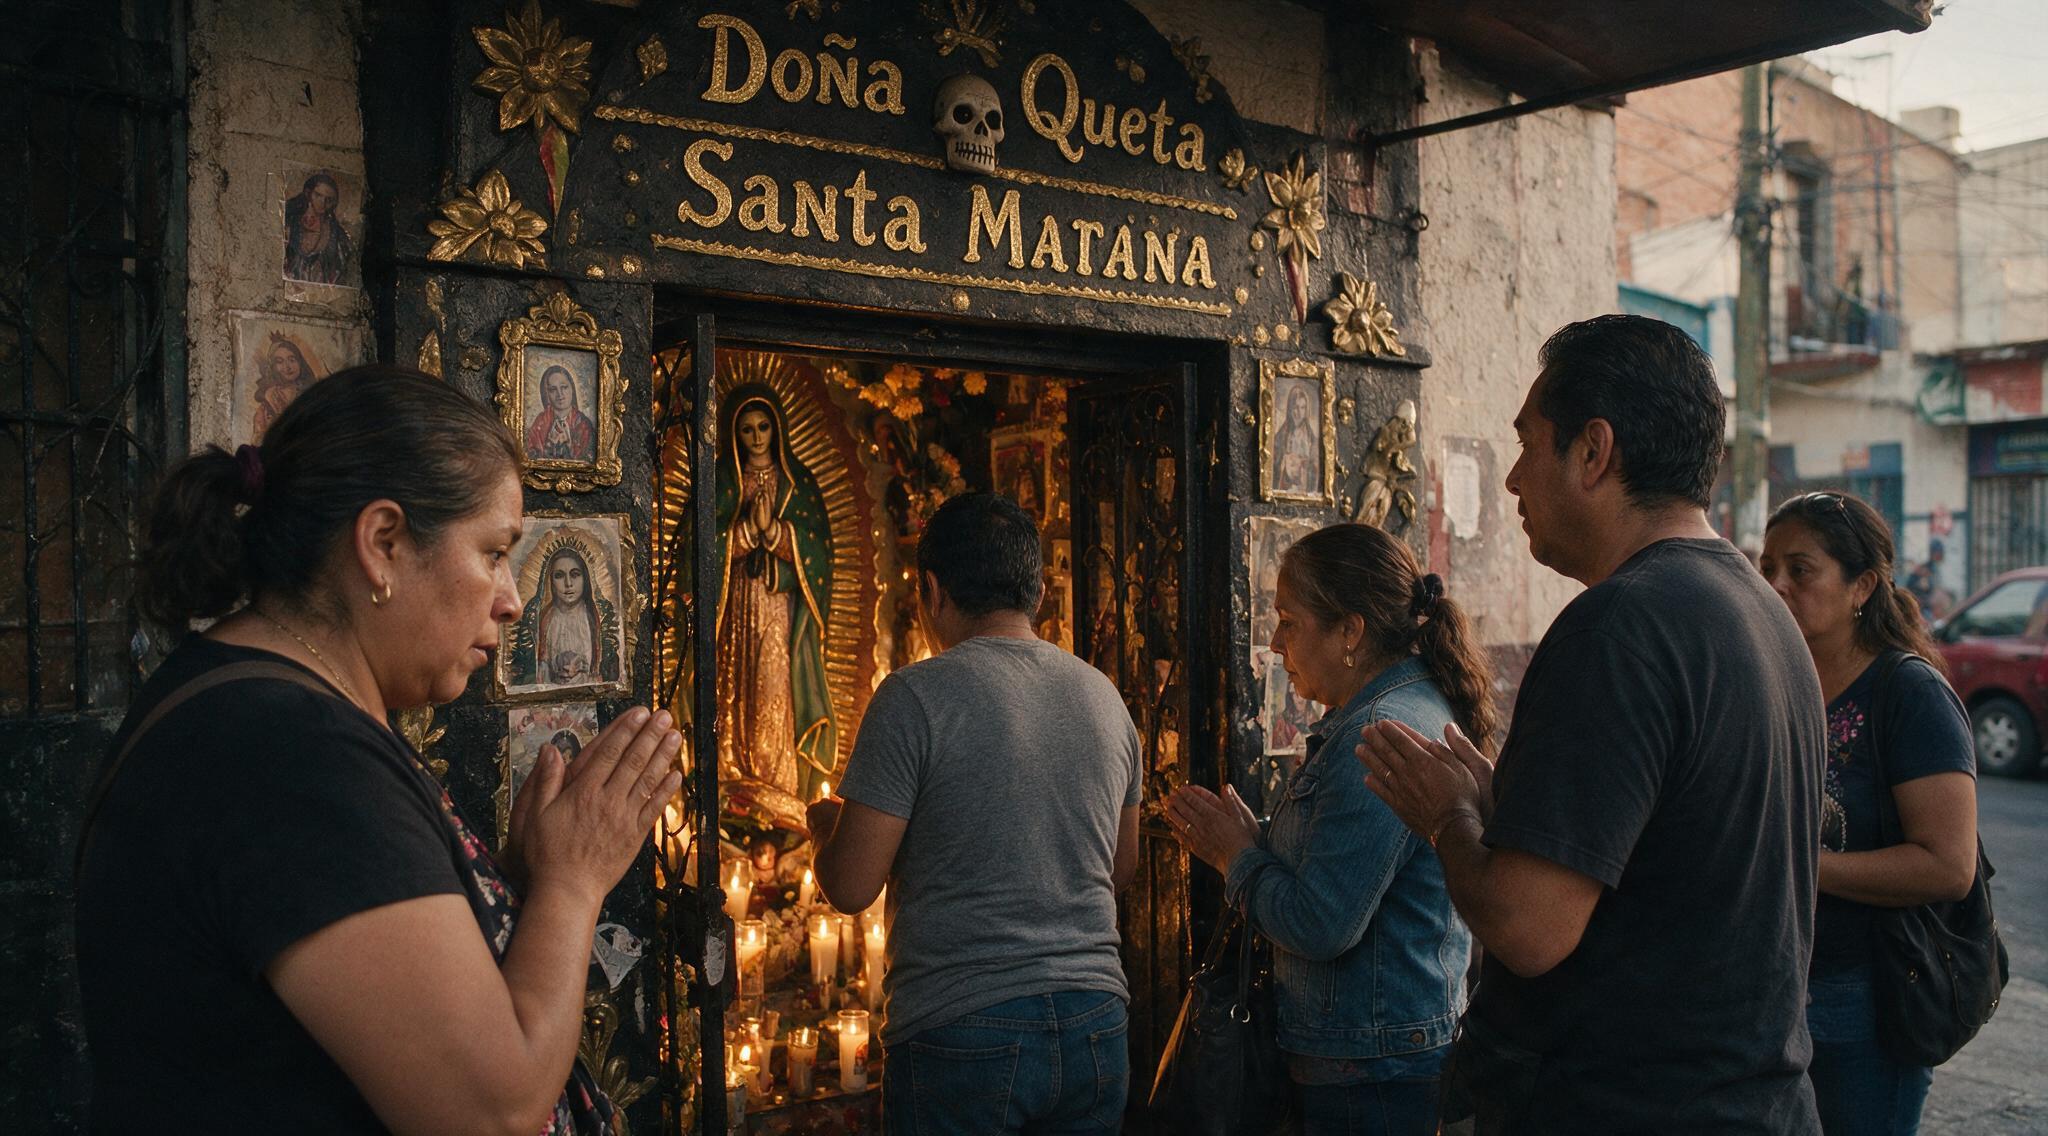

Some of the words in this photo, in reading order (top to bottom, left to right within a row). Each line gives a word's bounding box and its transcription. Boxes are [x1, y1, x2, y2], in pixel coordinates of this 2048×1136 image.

[698, 13, 906, 115] Doña
[1021, 53, 1207, 172] Queta
[678, 139, 927, 254] Santa
